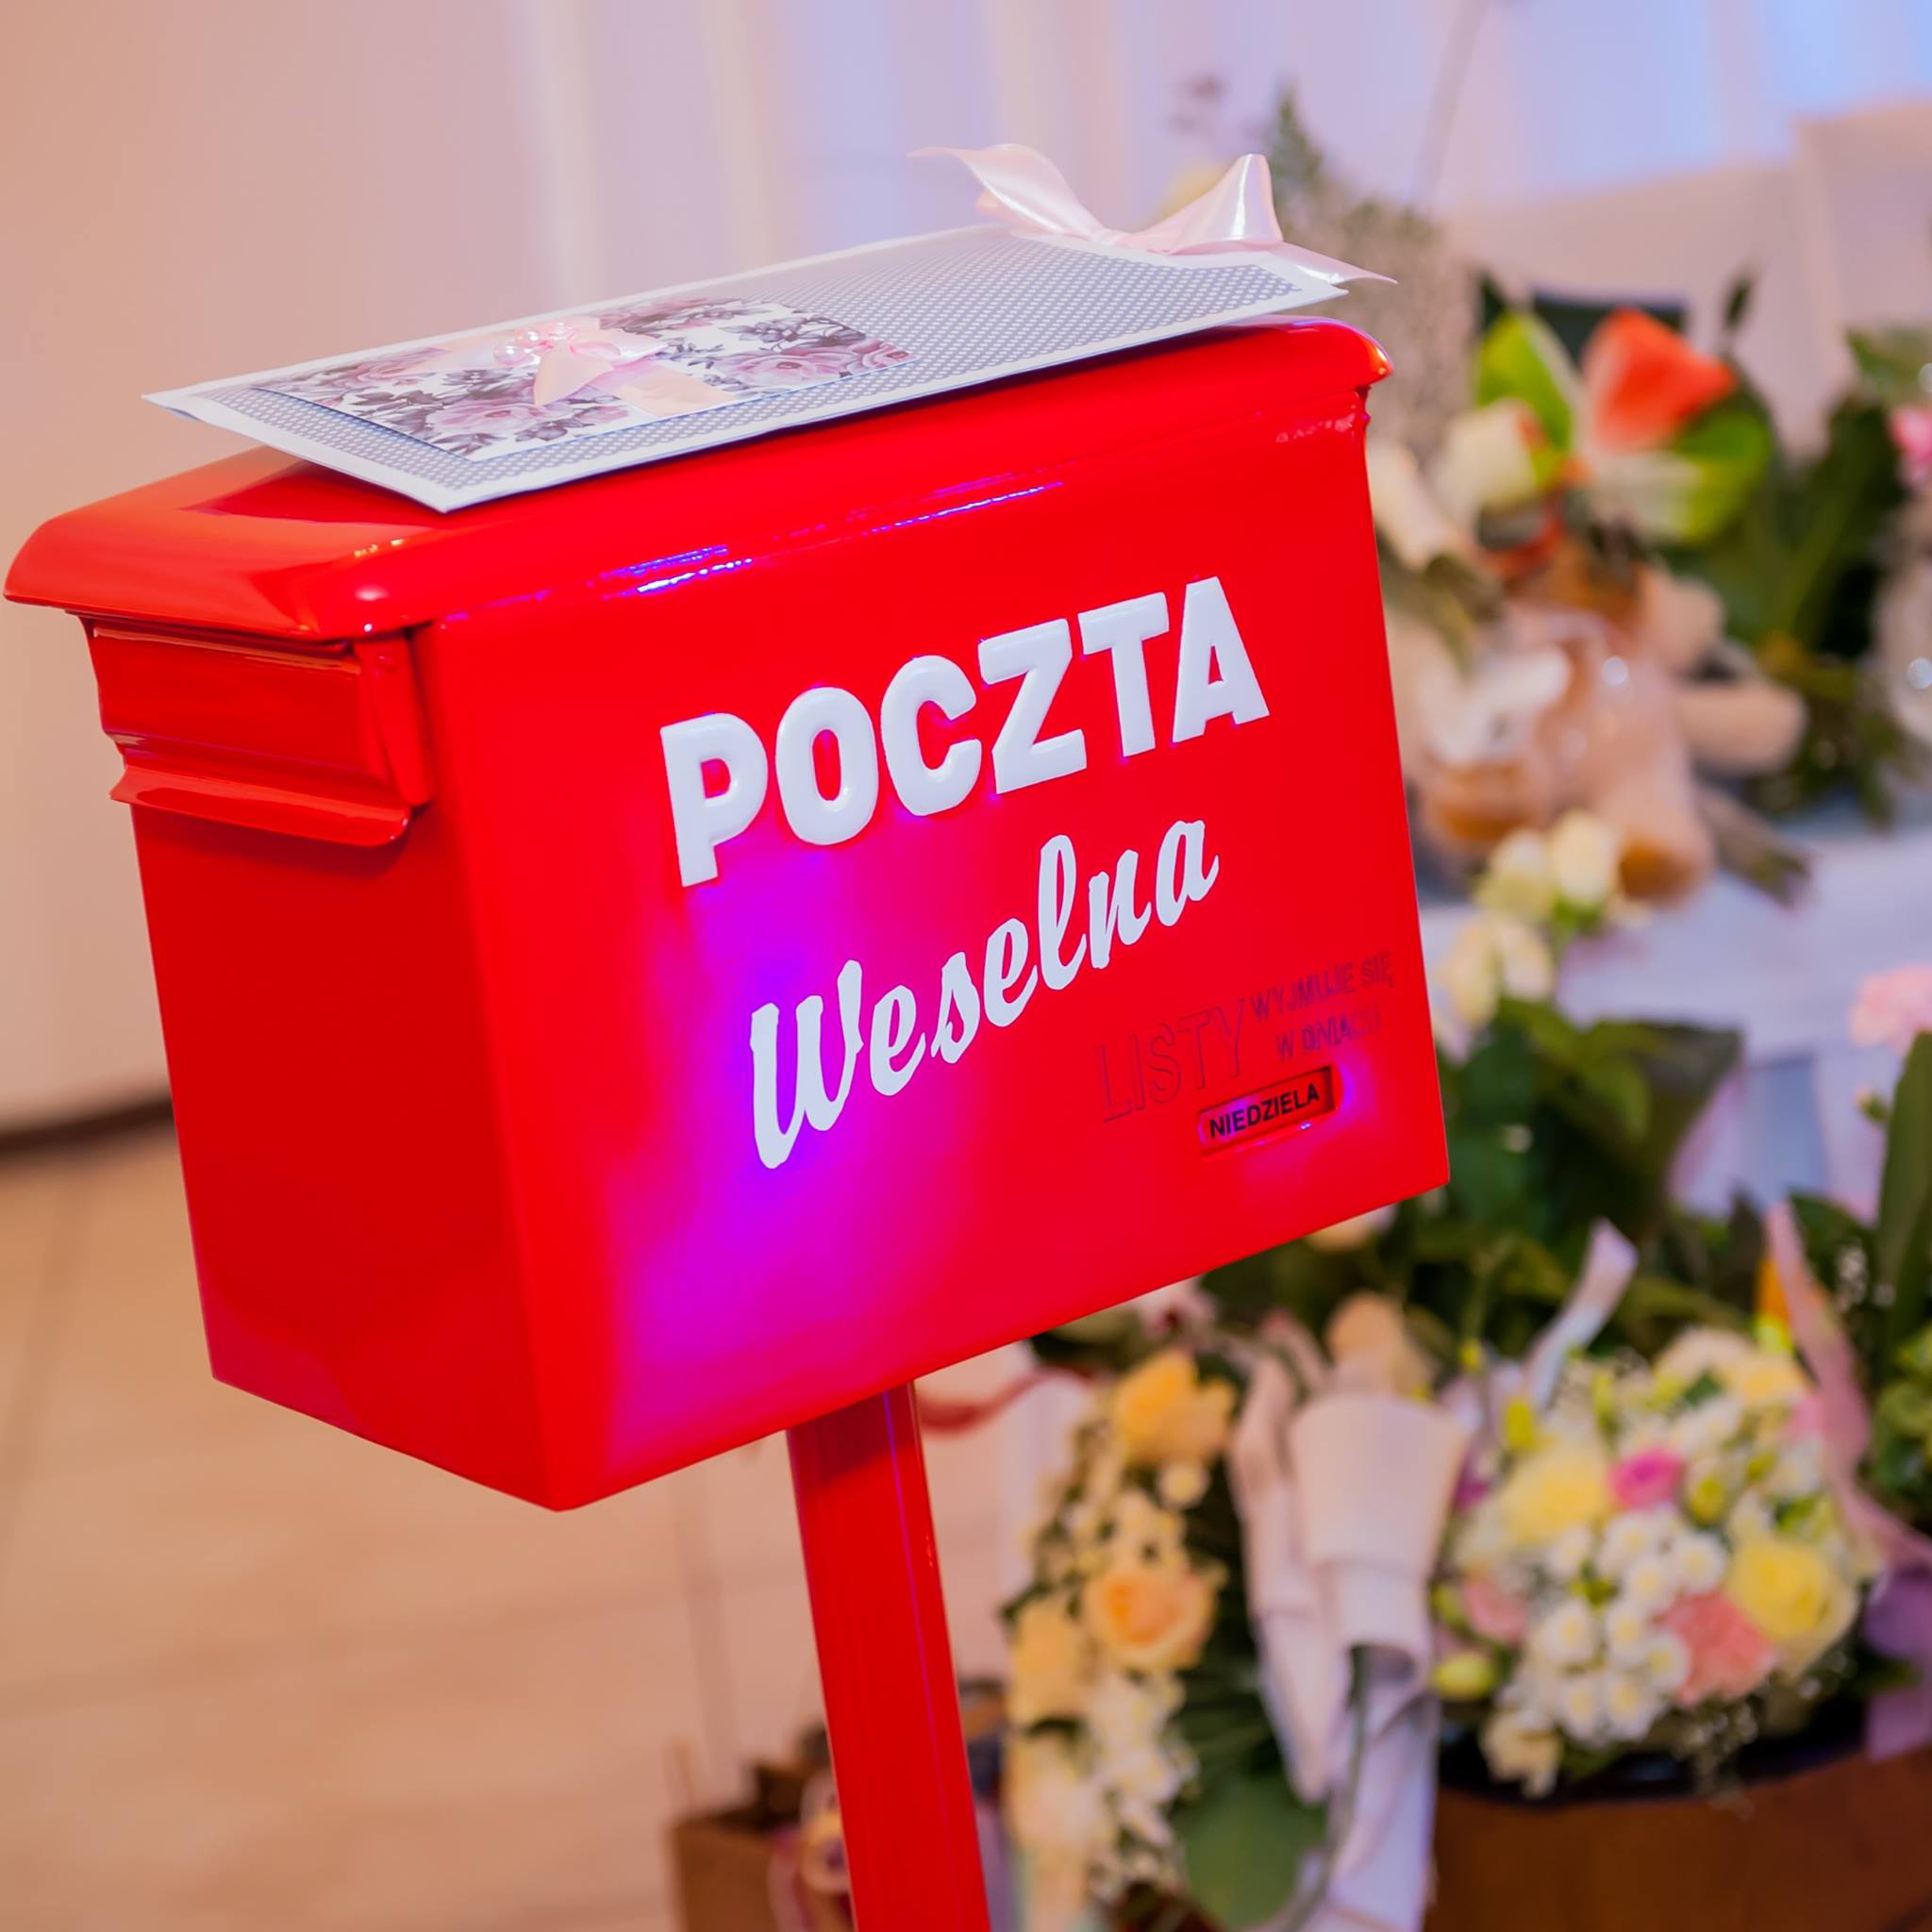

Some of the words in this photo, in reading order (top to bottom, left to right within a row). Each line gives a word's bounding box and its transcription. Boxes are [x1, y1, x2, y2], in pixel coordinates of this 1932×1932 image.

[660, 577, 1269, 887] POCZTA
[751, 820, 1220, 1169] Weselna
[1250, 962, 1356, 1023] WYJMUJE
[1360, 950, 1395, 988] SIĘ
[1097, 999, 1245, 1123] LISTY
[1275, 1030, 1295, 1062] W
[1209, 1083, 1320, 1139] NIEDZIELA
